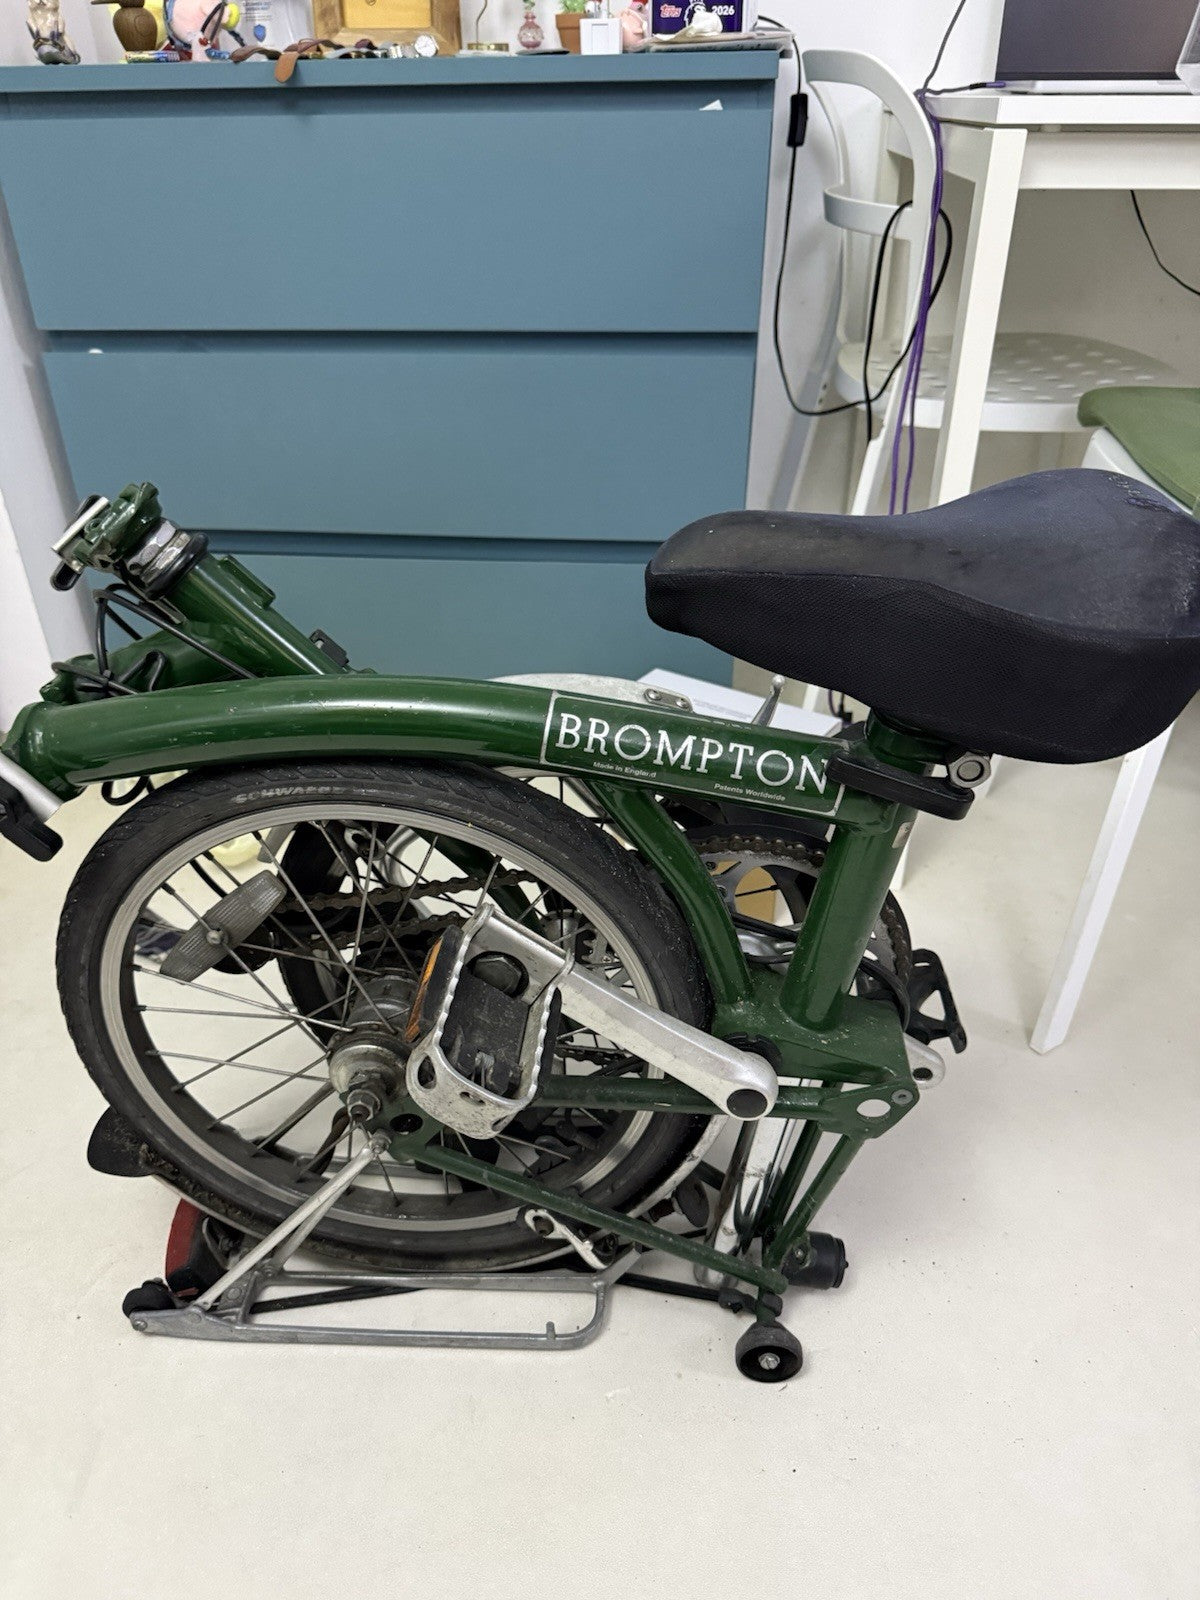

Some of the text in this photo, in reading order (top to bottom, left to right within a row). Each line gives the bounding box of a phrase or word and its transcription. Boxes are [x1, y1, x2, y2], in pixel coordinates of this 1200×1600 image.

[711, 5, 735, 16] 2026
[555, 712, 828, 795] BROMPTON
[593, 761, 614, 770] Made
[615, 765, 623, 773] in
[714, 783, 786, 802] Patents Worldwide
